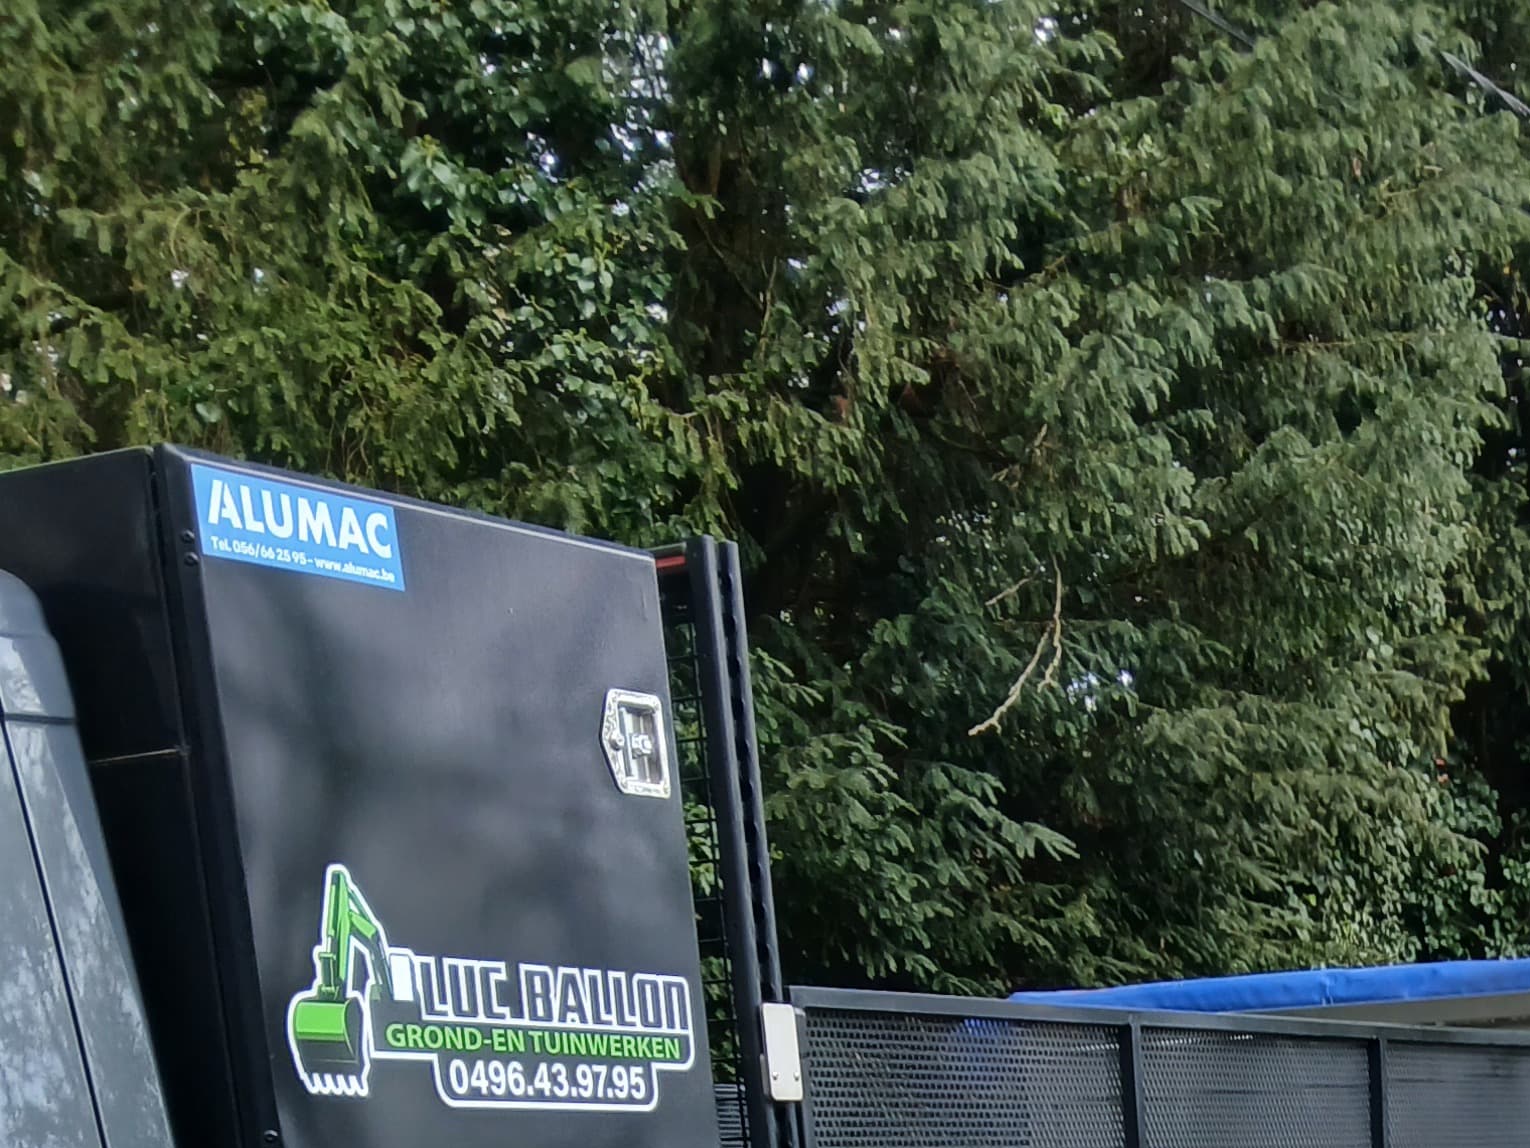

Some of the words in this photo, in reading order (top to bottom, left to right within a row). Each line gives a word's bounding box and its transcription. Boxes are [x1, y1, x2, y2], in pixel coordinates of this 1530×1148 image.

[208, 479, 392, 559] ALUMAC
[276, 548, 291, 563] 25
[314, 557, 395, 583] www.alumac.be
[416, 956, 508, 1020] LUC
[519, 963, 691, 1033] BALLON
[385, 1023, 524, 1051] GROND-EN
[533, 1031, 681, 1059] TUINWERKEN
[449, 1059, 646, 1099] 0496.43.97.95
